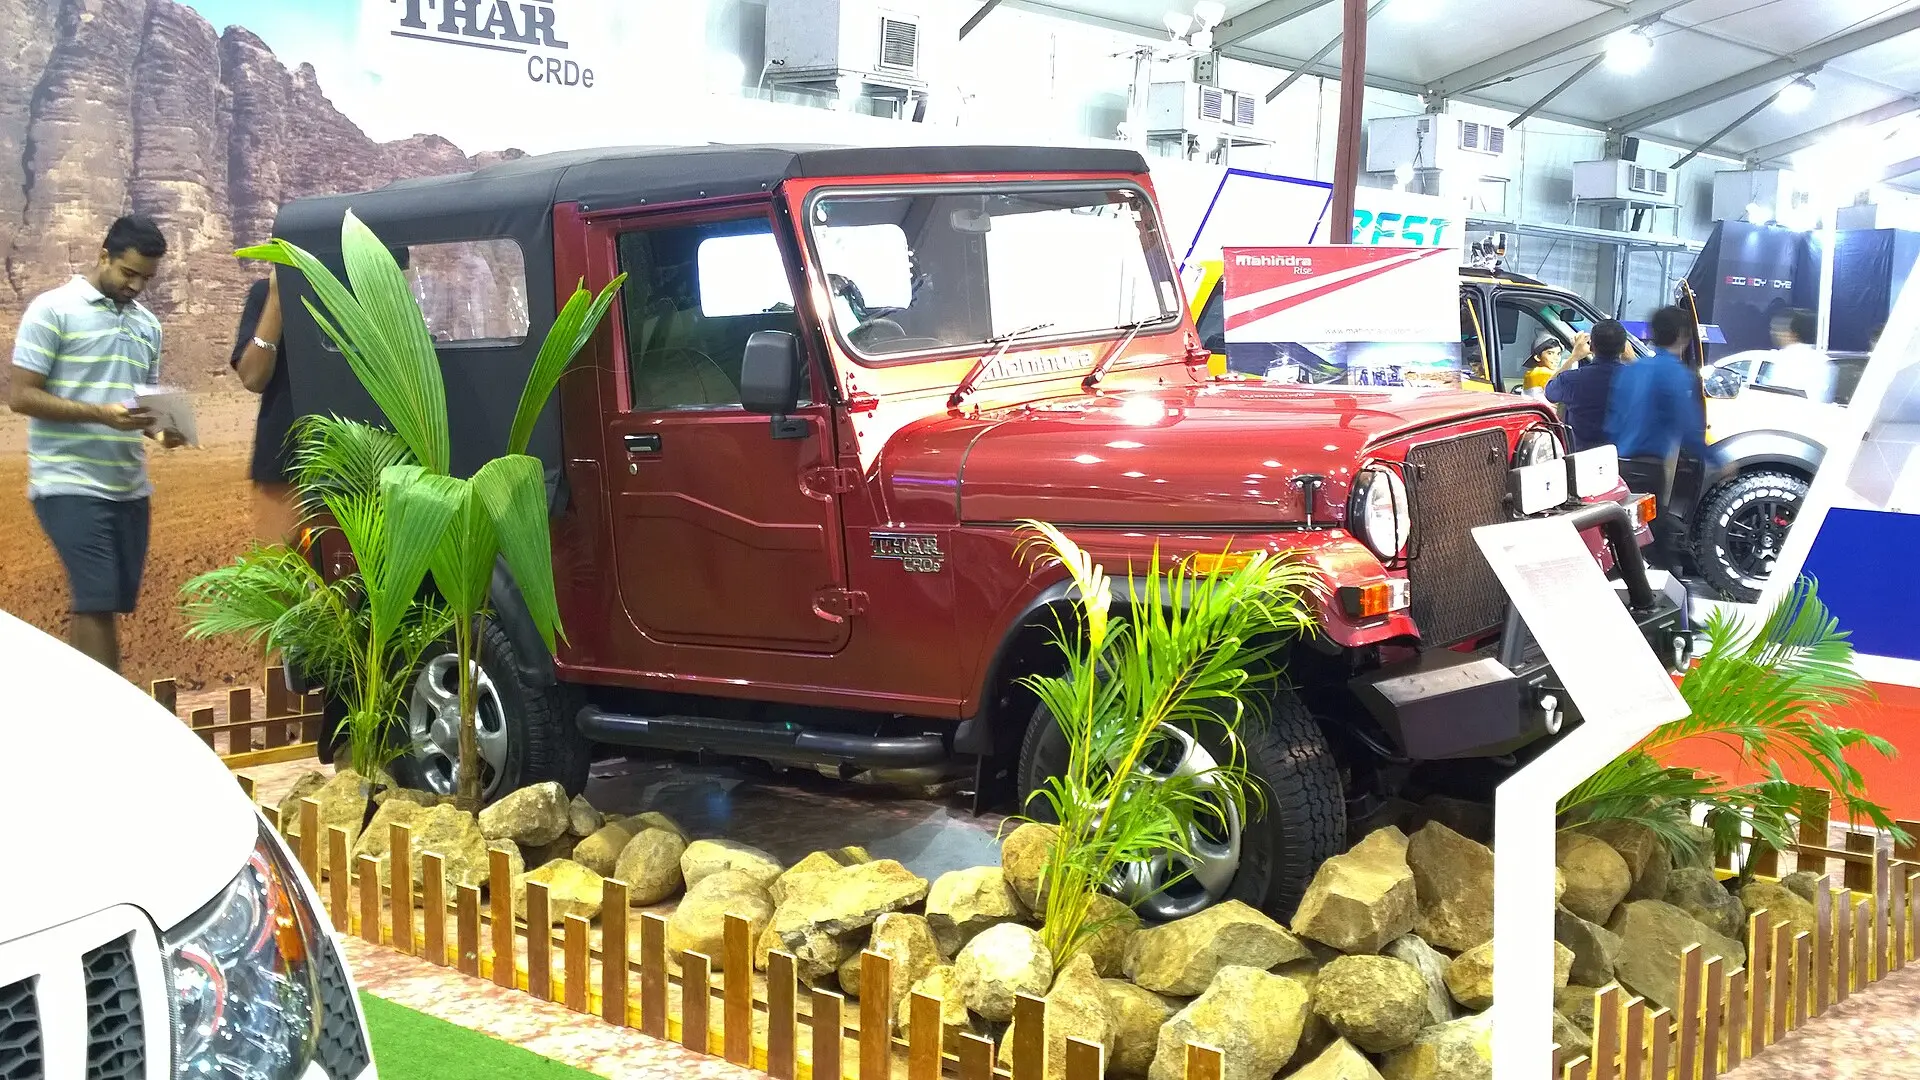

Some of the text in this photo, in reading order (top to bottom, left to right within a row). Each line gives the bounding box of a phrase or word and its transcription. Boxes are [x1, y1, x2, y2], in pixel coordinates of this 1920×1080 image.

[390, 0, 569, 49] THAR
[527, 55, 594, 88] CRDe
[871, 537, 944, 555] THAR
[903, 557, 941, 572] CRDe
